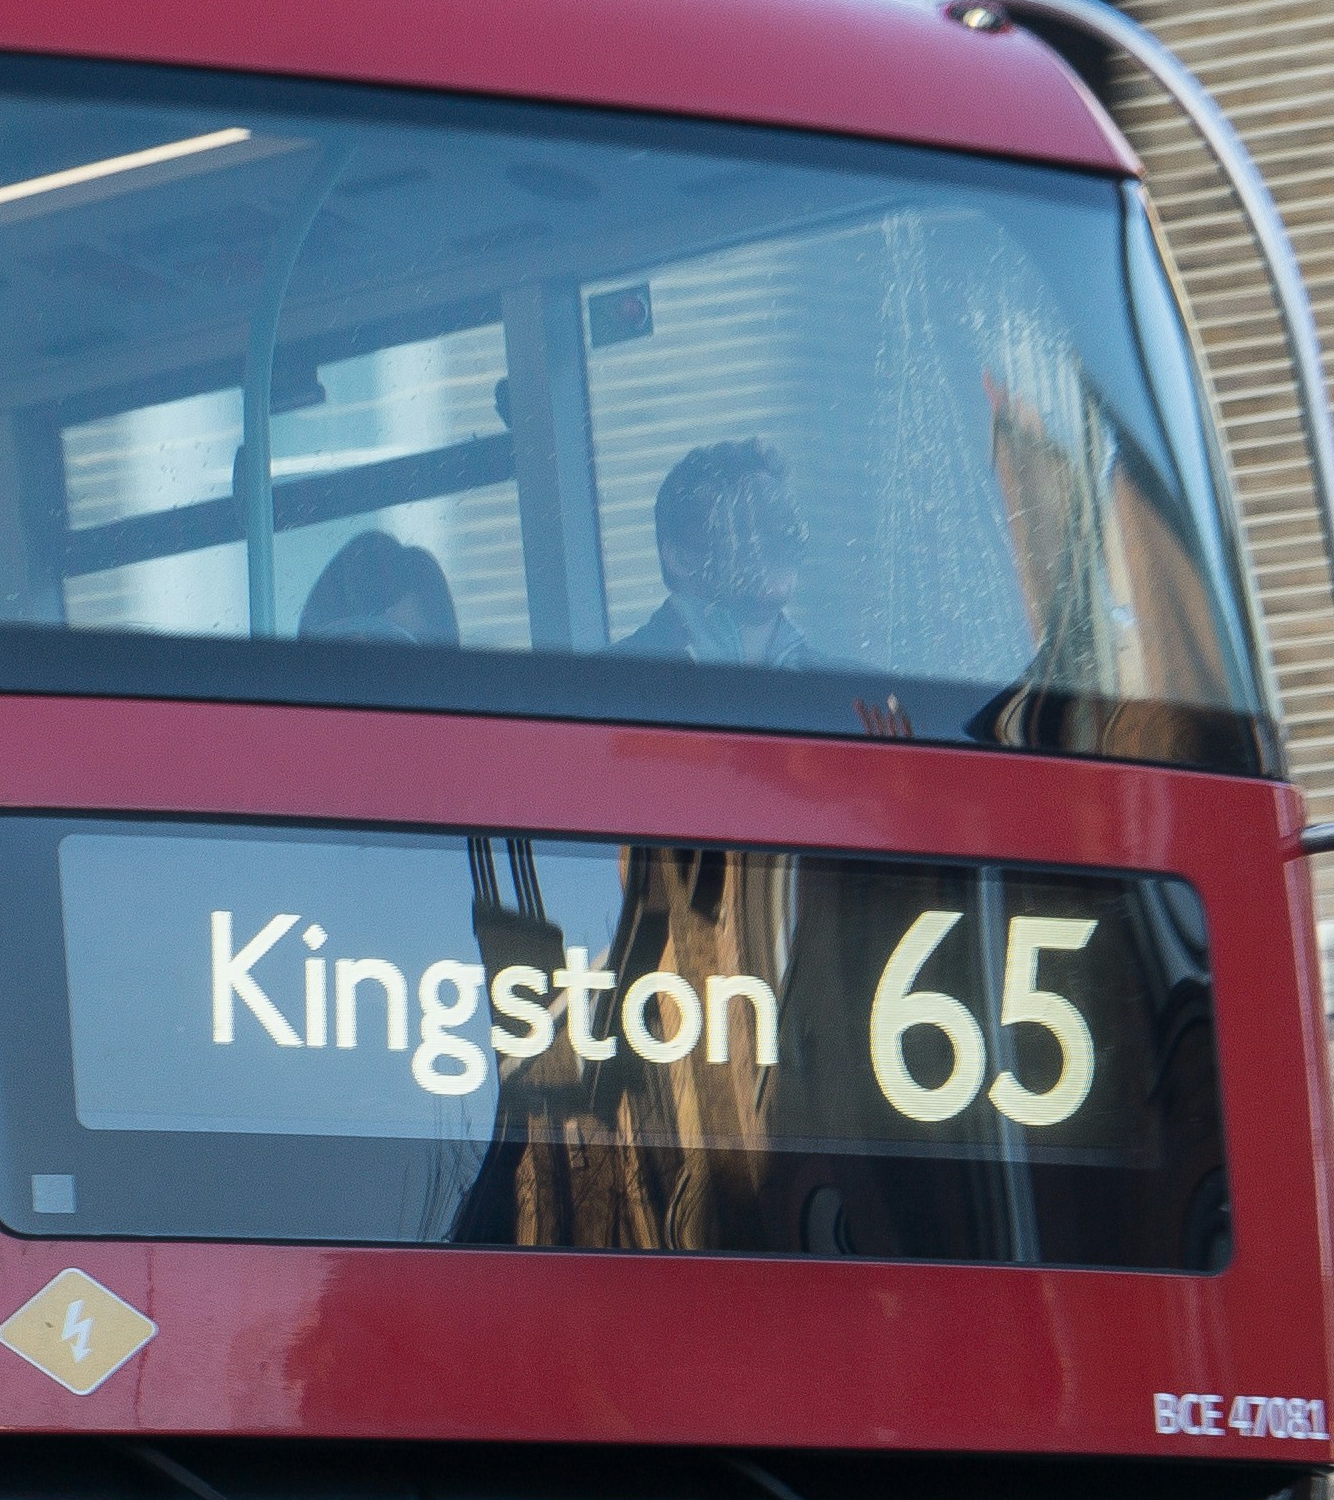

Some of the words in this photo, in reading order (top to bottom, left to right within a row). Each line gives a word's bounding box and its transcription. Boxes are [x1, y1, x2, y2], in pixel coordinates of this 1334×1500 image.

[208, 909, 779, 1096] Kingston
[869, 909, 1099, 1126] 65
[1152, 1392, 1226, 1437] BCE
[1228, 1395, 1331, 1441] 47081
